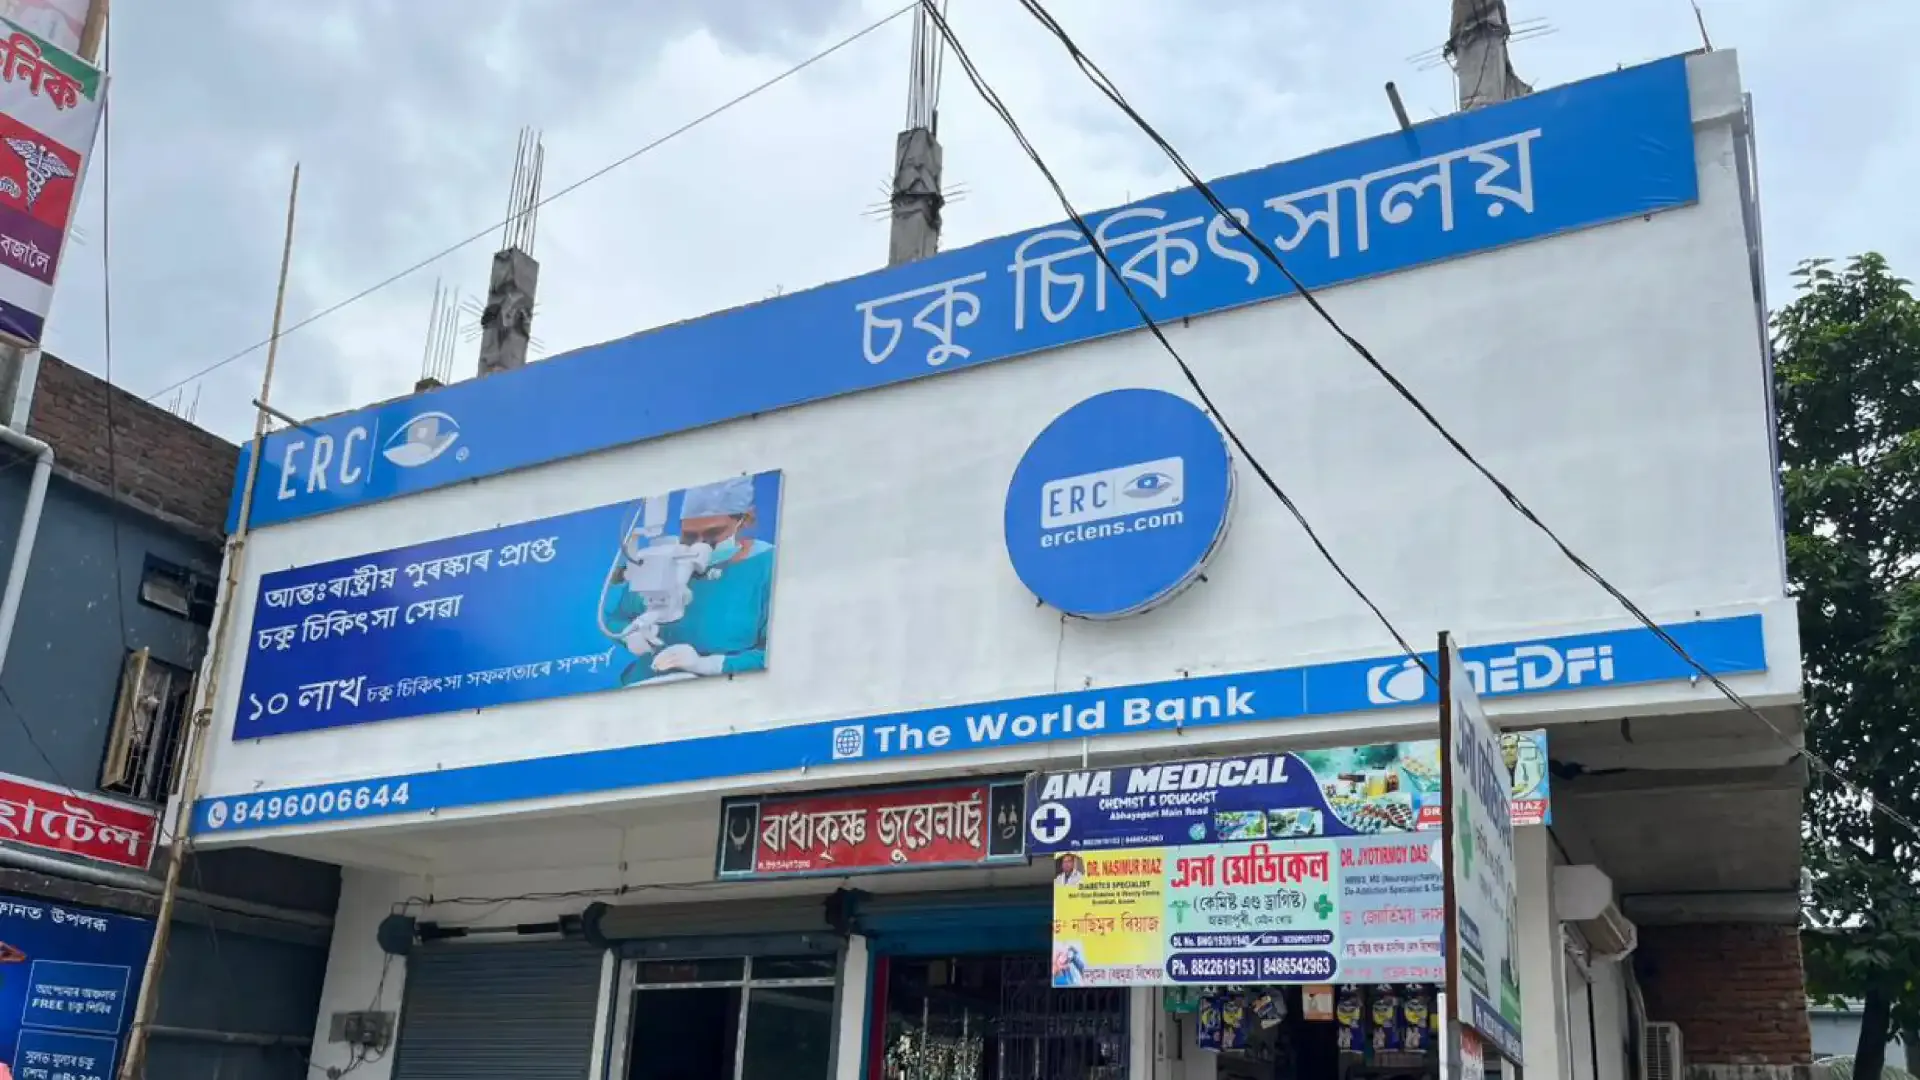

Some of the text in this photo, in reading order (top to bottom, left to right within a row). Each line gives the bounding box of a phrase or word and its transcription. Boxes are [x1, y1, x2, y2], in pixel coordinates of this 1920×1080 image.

[856, 127, 1542, 366] চকু চিকিৎসালয়
[277, 425, 367, 502] ERC
[1049, 481, 1108, 518] ERC
[1041, 510, 1183, 548] erclens.com
[257, 624, 297, 650] চকু
[302, 606, 399, 643] চিকিৎসা
[248, 691, 288, 721] ১০
[298, 675, 367, 712] লাখ
[367, 684, 393, 703] চকু
[396, 674, 463, 697] চিকিৎসা
[874, 686, 1256, 752] The World Bank
[232, 781, 409, 824] 8496006644
[1040, 770, 1111, 800] ANA
[1098, 795, 1147, 811] CHEMIST
[1161, 807, 1183, 818] Main
[1185, 806, 1209, 816] Road
[1171, 844, 1330, 888] এনা মেডিকেল
[1171, 959, 1189, 976] Ph.
[1191, 957, 1255, 976] 8822619153
[1263, 956, 1331, 975] 8486542963
[32, 998, 64, 1011] FREE
